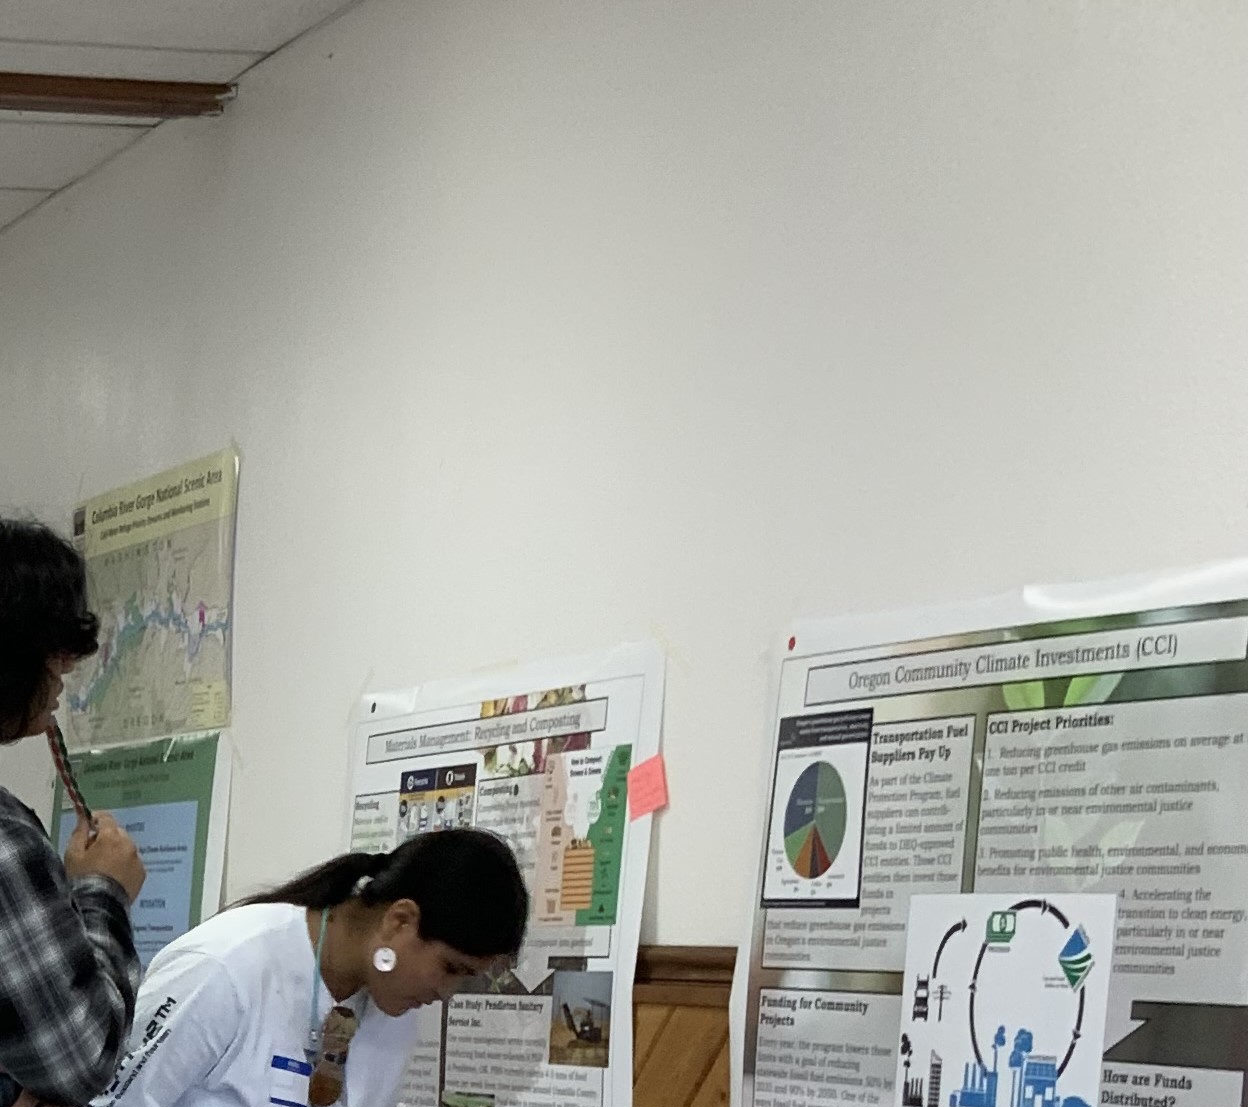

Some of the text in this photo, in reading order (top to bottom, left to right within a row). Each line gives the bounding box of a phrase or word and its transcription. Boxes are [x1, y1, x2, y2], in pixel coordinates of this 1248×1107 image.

[849, 634, 1178, 691] Oregon Community Climate Investments (CCI)
[873, 727, 943, 745] Transportation
[946, 723, 968, 738] Fuel
[989, 712, 1114, 735] CCI Project Priorities:
[871, 745, 951, 766] Suppliers Pay Up
[761, 995, 869, 1016] Funding for Community
[760, 1013, 795, 1028] Projects
[1104, 1069, 1193, 1090] How are Funds
